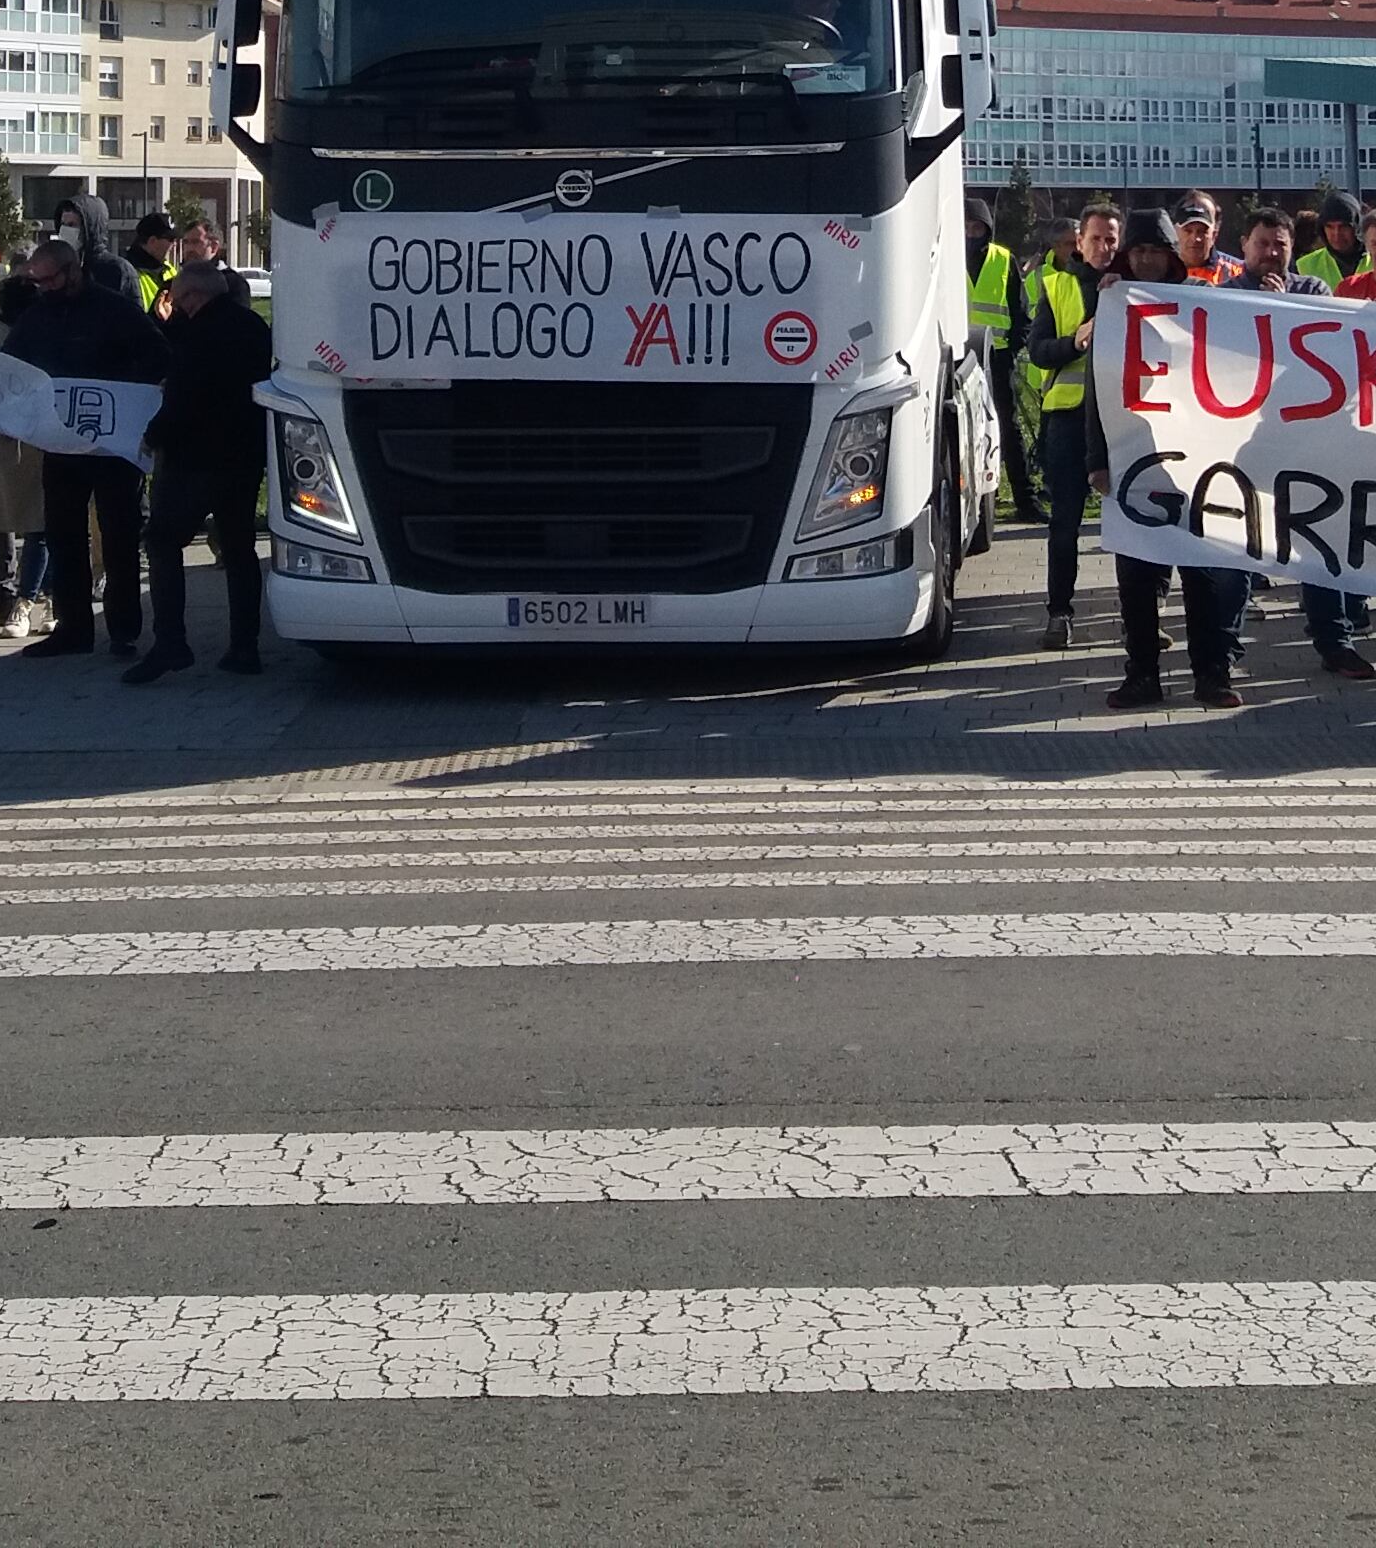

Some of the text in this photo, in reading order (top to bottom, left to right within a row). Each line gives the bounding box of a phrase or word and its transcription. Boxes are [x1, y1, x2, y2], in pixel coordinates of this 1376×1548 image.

[366, 178, 382, 203] L
[824, 220, 860, 250] HIRU
[368, 230, 811, 298] GOBIERNO VASCO
[370, 302, 730, 367] DIALOGO YA!!!
[314, 340, 347, 374] HIRU
[824, 343, 860, 381] HIRU
[525, 601, 645, 624] 6502 LMH
